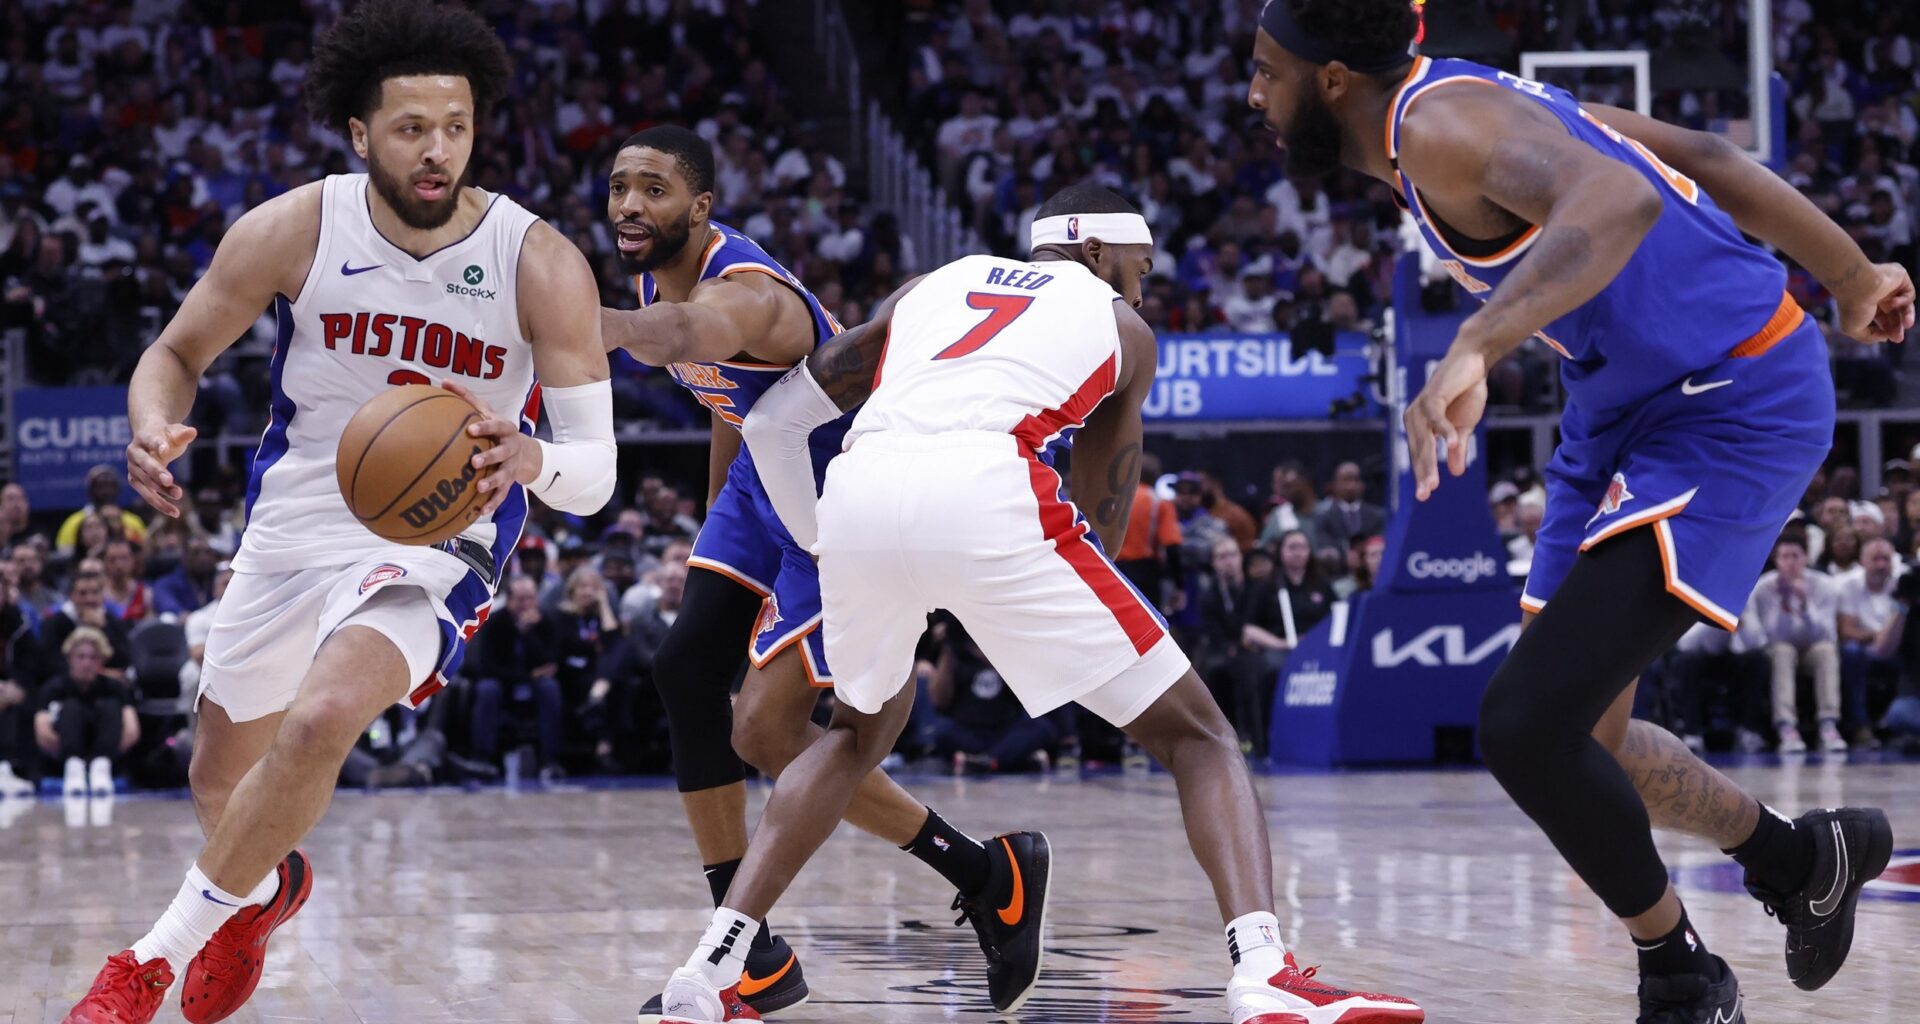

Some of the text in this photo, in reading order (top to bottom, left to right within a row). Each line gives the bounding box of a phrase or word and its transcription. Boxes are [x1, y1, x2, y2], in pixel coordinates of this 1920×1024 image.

[446, 283, 496, 300] StockX
[986, 267, 1055, 290] REED
[930, 291, 1036, 361] 7
[320, 312, 507, 380] PISTONS
[18, 415, 130, 449] CURE
[1407, 551, 1497, 584] Google
